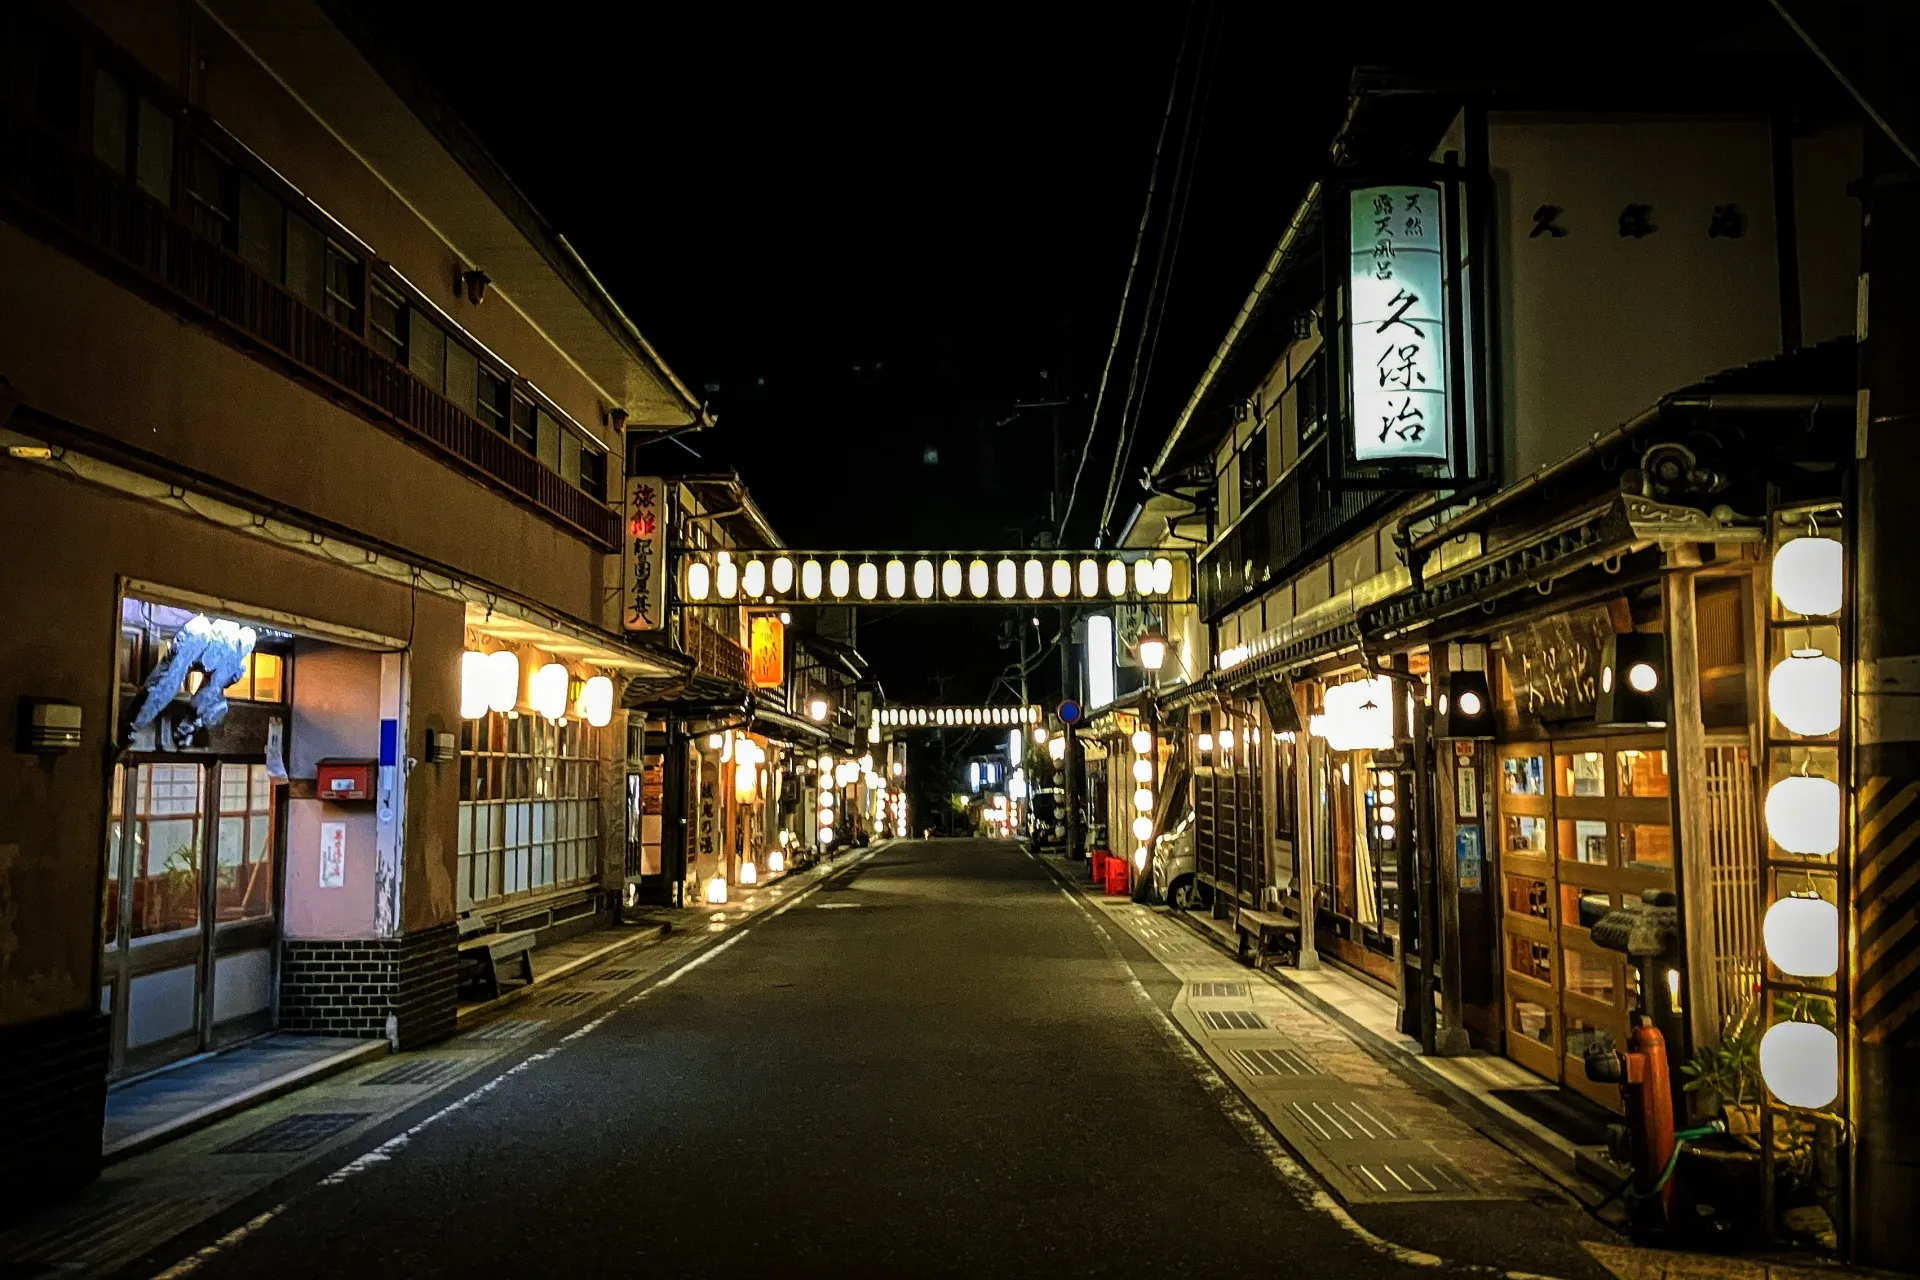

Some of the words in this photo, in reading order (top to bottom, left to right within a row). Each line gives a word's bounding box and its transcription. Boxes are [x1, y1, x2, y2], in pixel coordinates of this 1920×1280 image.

[1404, 193, 1424, 237] 天然
[1375, 287, 1427, 445] 久保治
